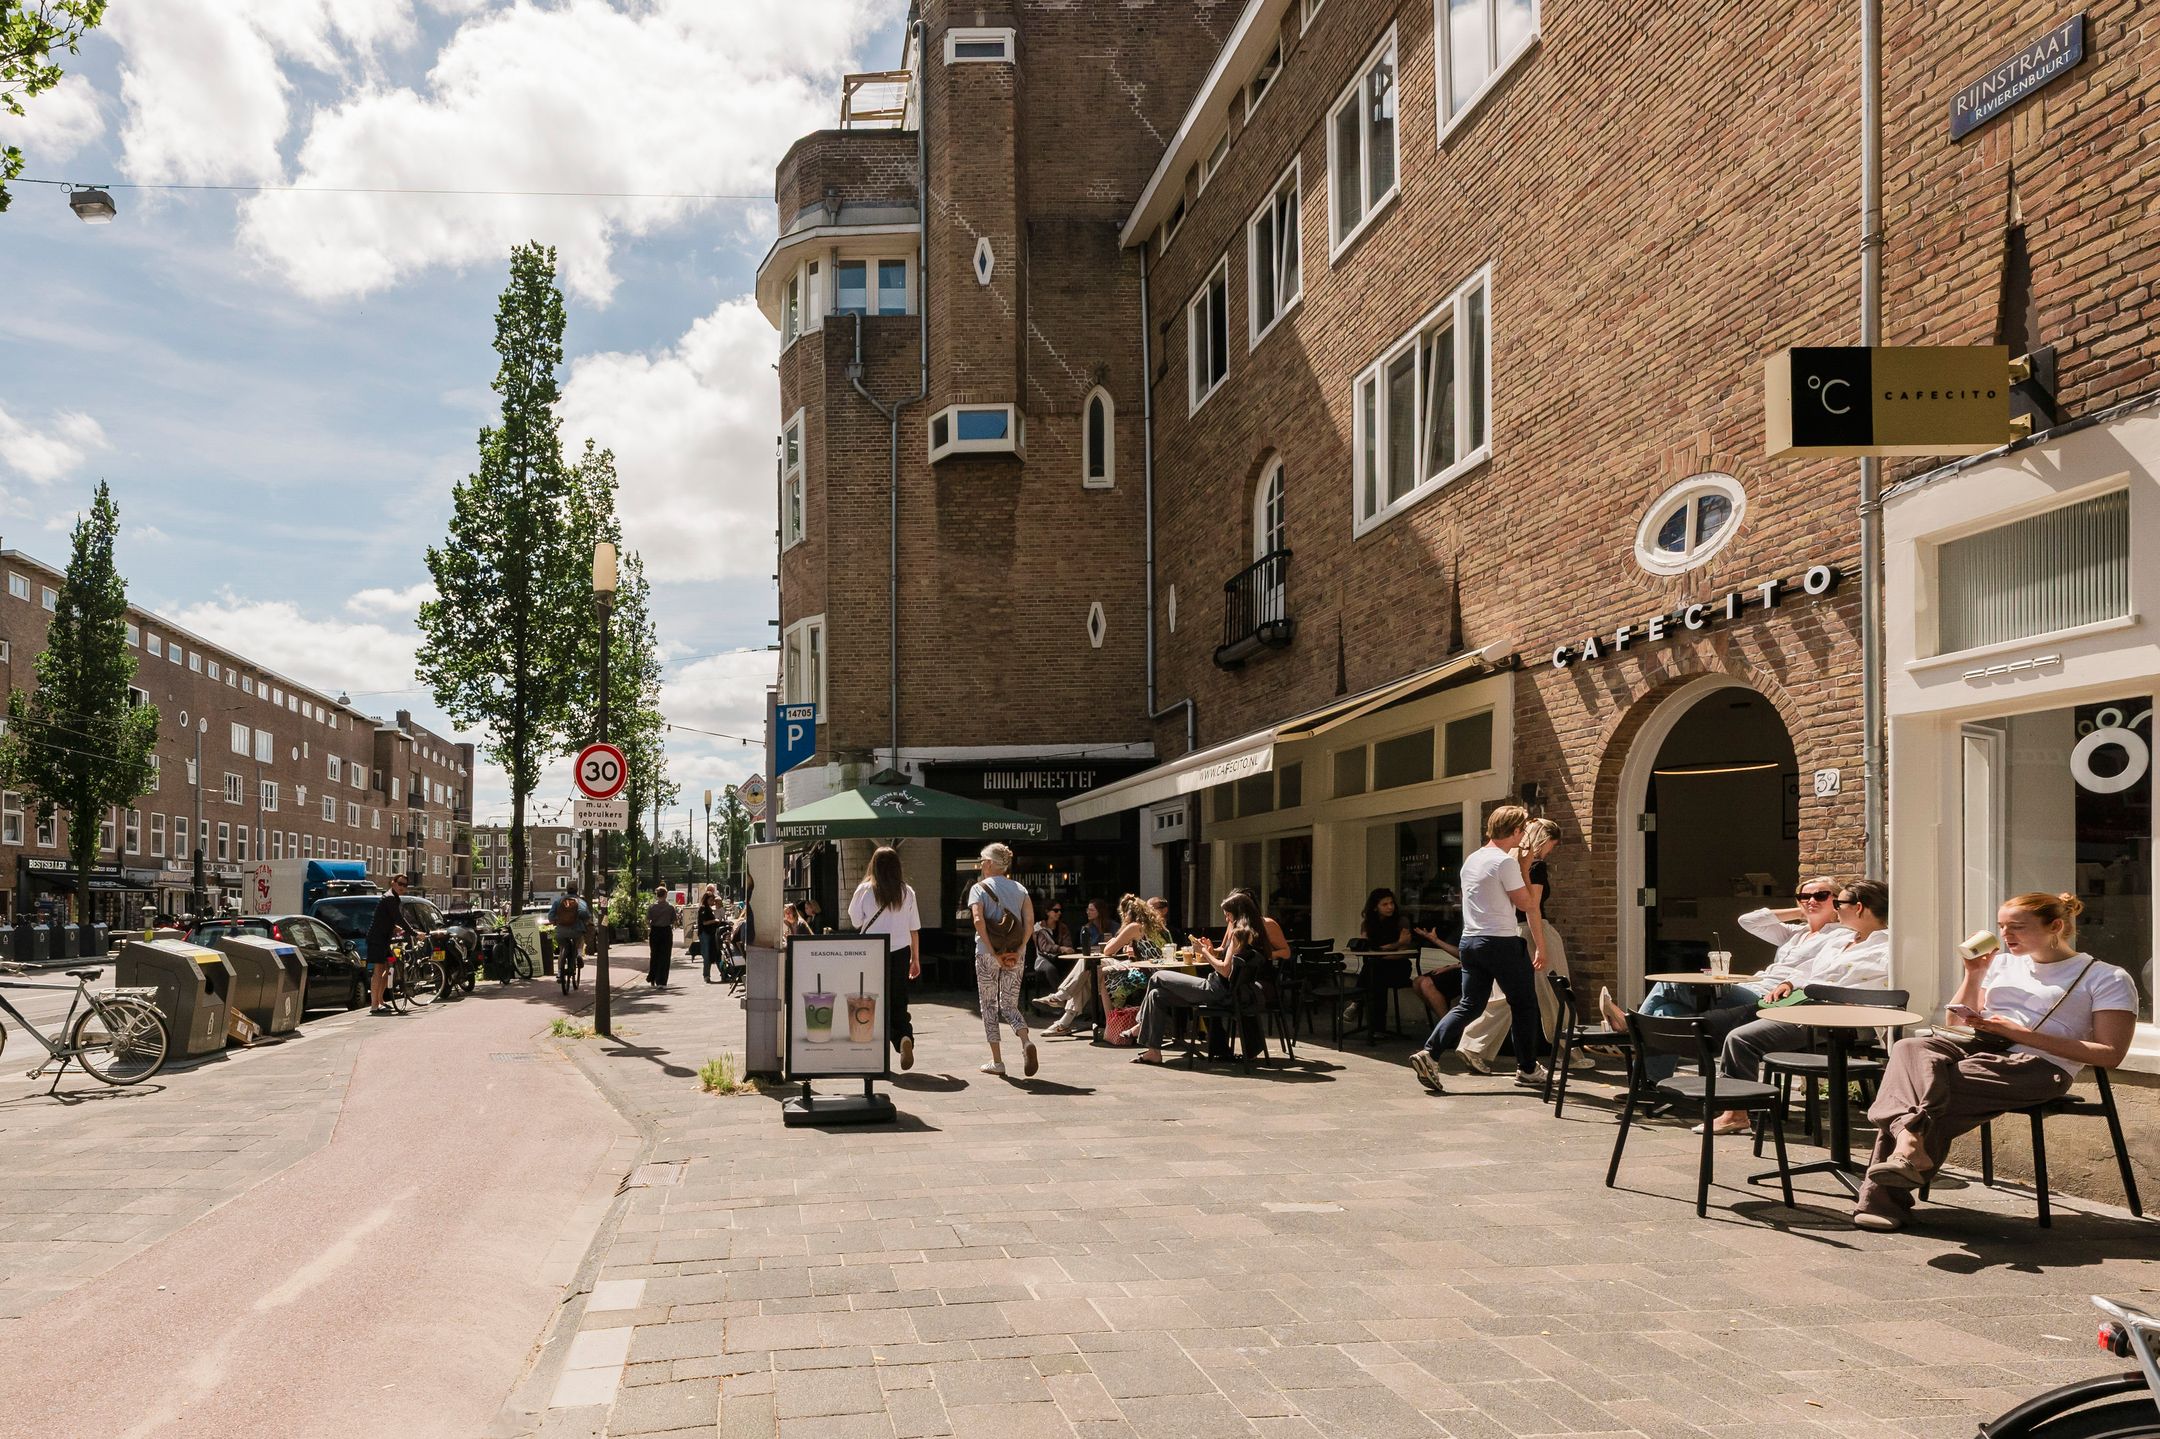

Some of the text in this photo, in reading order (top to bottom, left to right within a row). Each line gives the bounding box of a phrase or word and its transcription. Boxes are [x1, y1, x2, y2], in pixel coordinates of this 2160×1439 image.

[1956, 25, 2073, 116] RIJNSTRAAT
[1974, 49, 2071, 120] RIVIERENBUURT
[1884, 389, 1997, 400] CAFECITO
[1552, 564, 1834, 669] CAFECITO
[787, 709, 812, 718] 14705
[787, 724, 804, 751] P
[584, 761, 618, 781] 30
[1199, 754, 1258, 782] WWW.CAFECITO.NL
[983, 770, 1096, 790] BOUWMEESTER
[1815, 772, 1840, 794] 32
[578, 811, 623, 819] gebruikers
[582, 820, 618, 828] OV-baan
[28, 859, 67, 870] BESTSELLER
